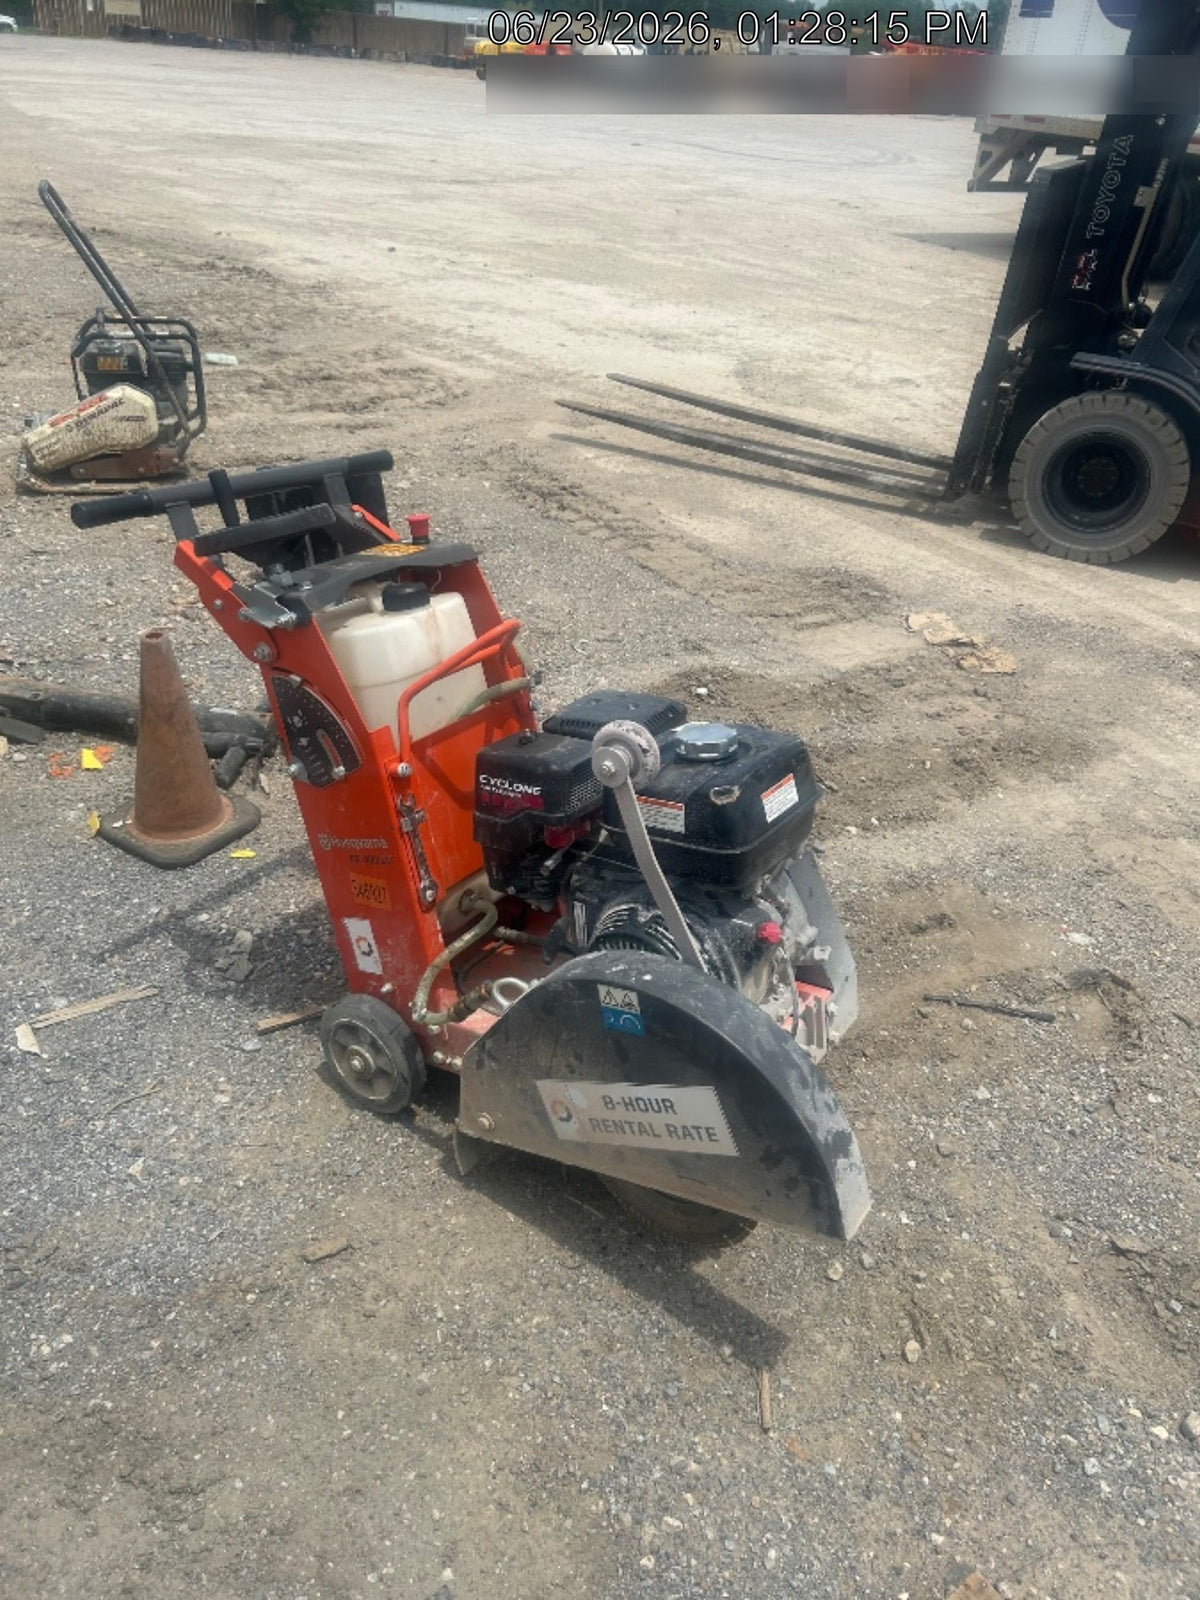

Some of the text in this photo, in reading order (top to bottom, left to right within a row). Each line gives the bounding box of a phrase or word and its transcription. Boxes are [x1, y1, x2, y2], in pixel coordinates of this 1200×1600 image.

[1086, 134, 1134, 239] TOYOTA
[479, 774, 542, 796] CYCLONE
[588, 1117, 719, 1142] RENTAL RATE
